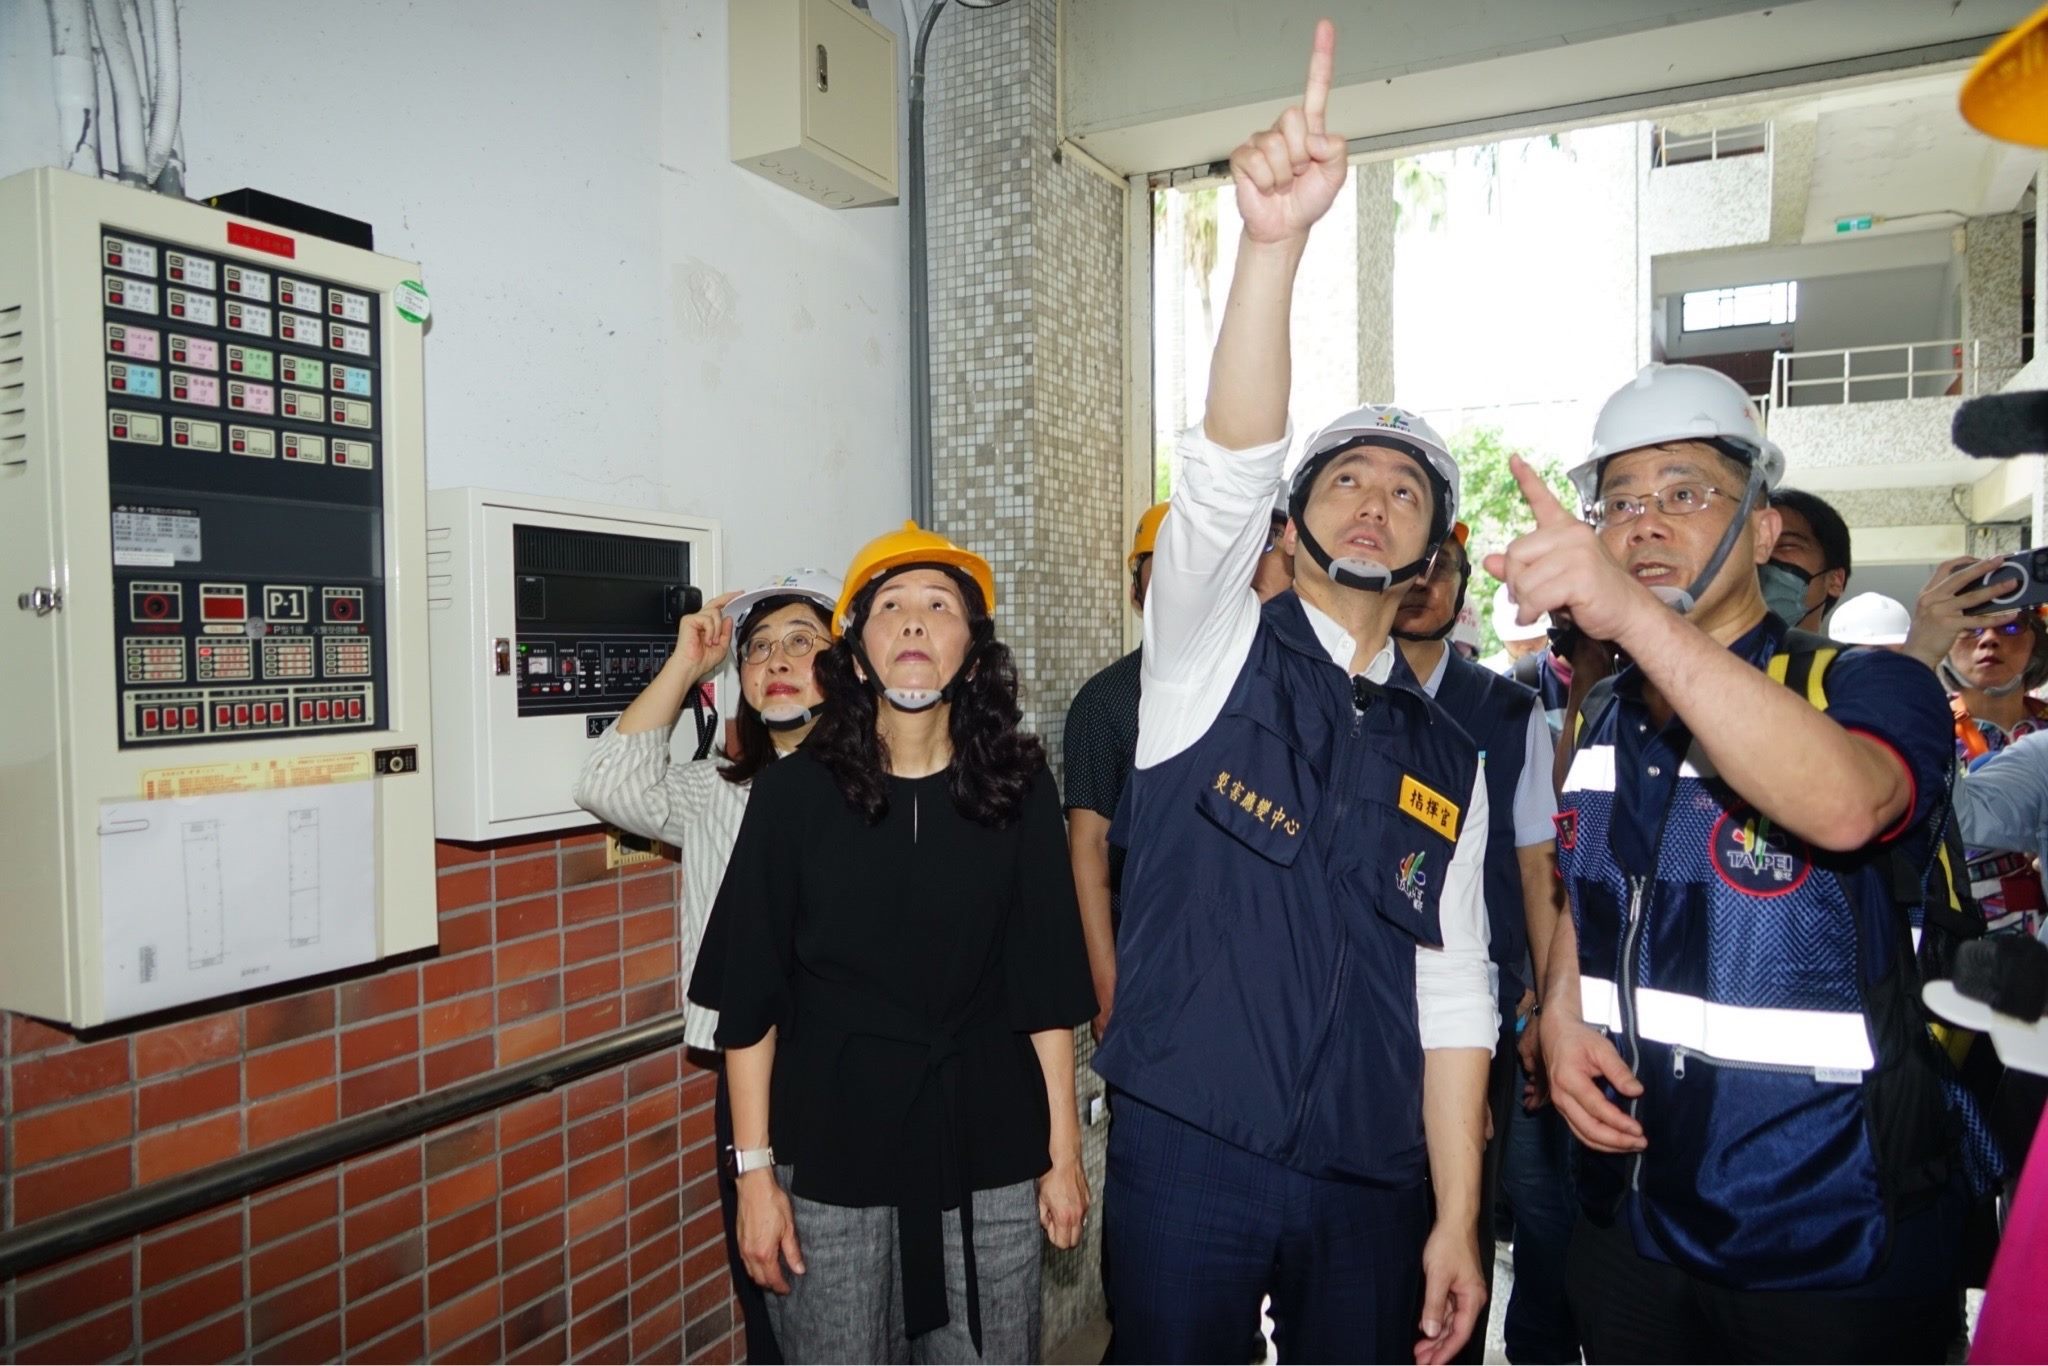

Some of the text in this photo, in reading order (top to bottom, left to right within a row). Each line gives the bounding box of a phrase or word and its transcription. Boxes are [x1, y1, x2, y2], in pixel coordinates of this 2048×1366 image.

[269, 591, 301, 617] P-1
[1212, 770, 1301, 837] 災害應變中心
[1409, 789, 1451, 828] 指揮官
[1727, 851, 1793, 873] TAIPEI
